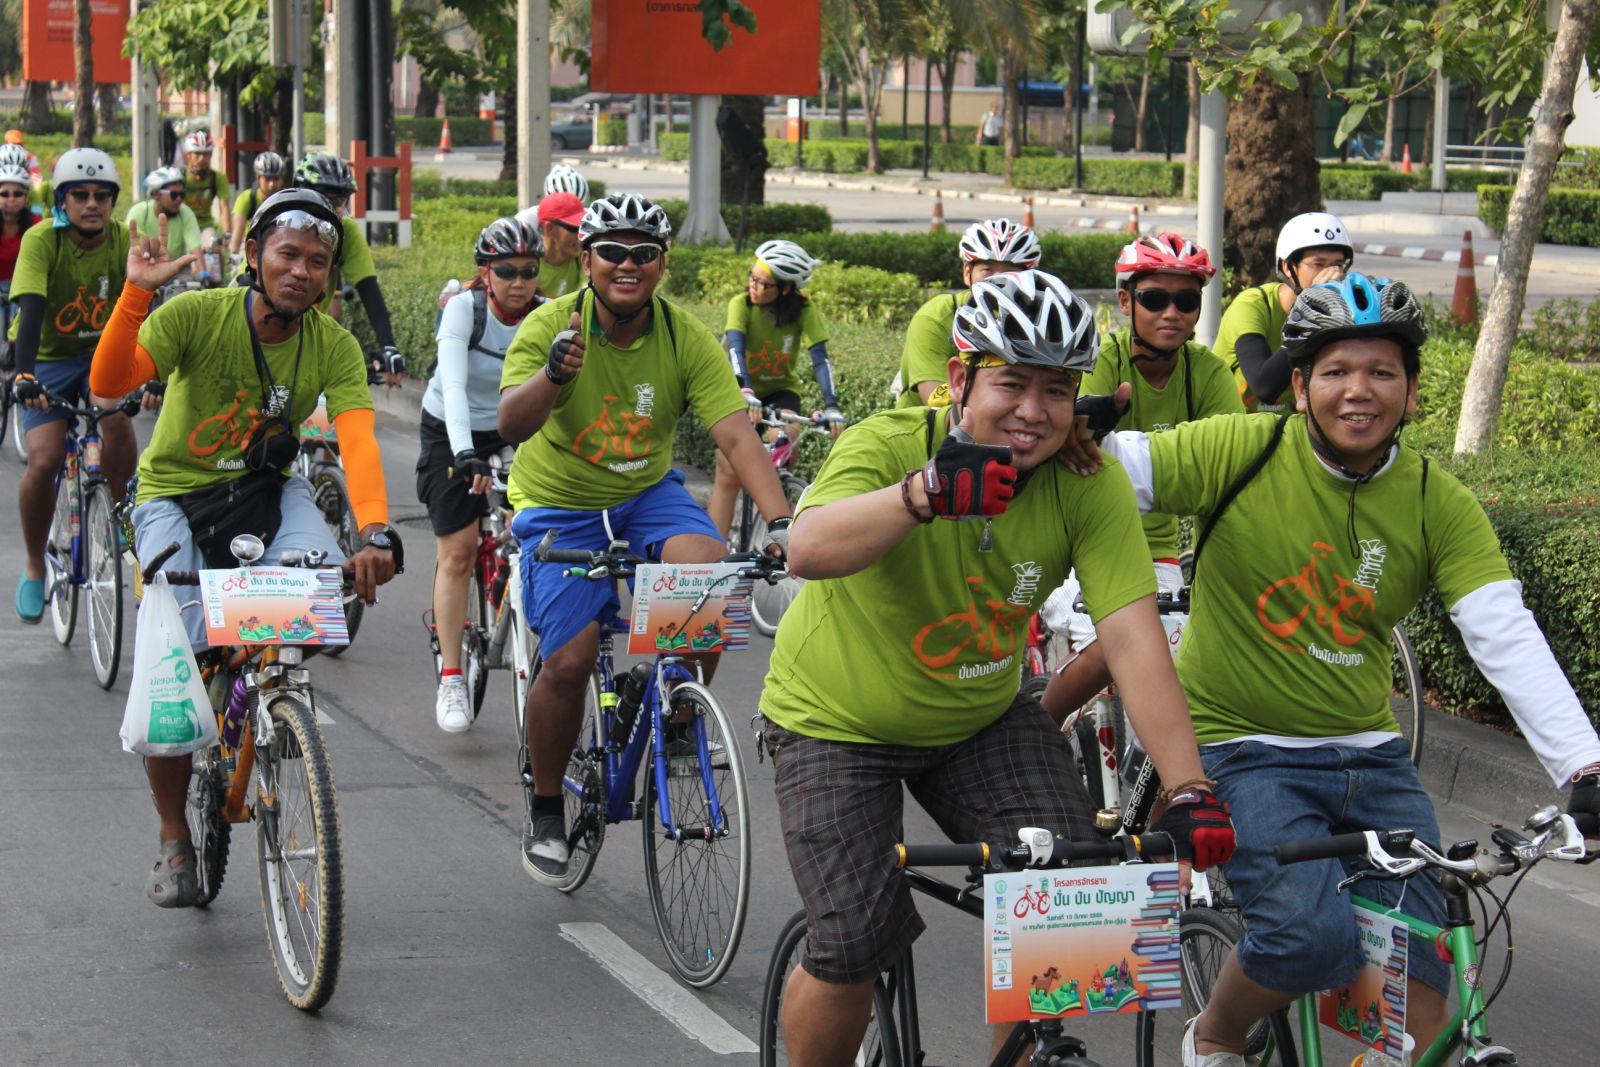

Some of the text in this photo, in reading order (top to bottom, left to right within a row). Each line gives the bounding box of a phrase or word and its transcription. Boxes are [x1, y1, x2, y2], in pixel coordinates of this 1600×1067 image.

[1122, 757, 1155, 828] ARYFISHER
[1053, 877, 1108, 888] โครงการจักรยาน
[1054, 889, 1135, 907] ปั่น ปัน ปัญญา
